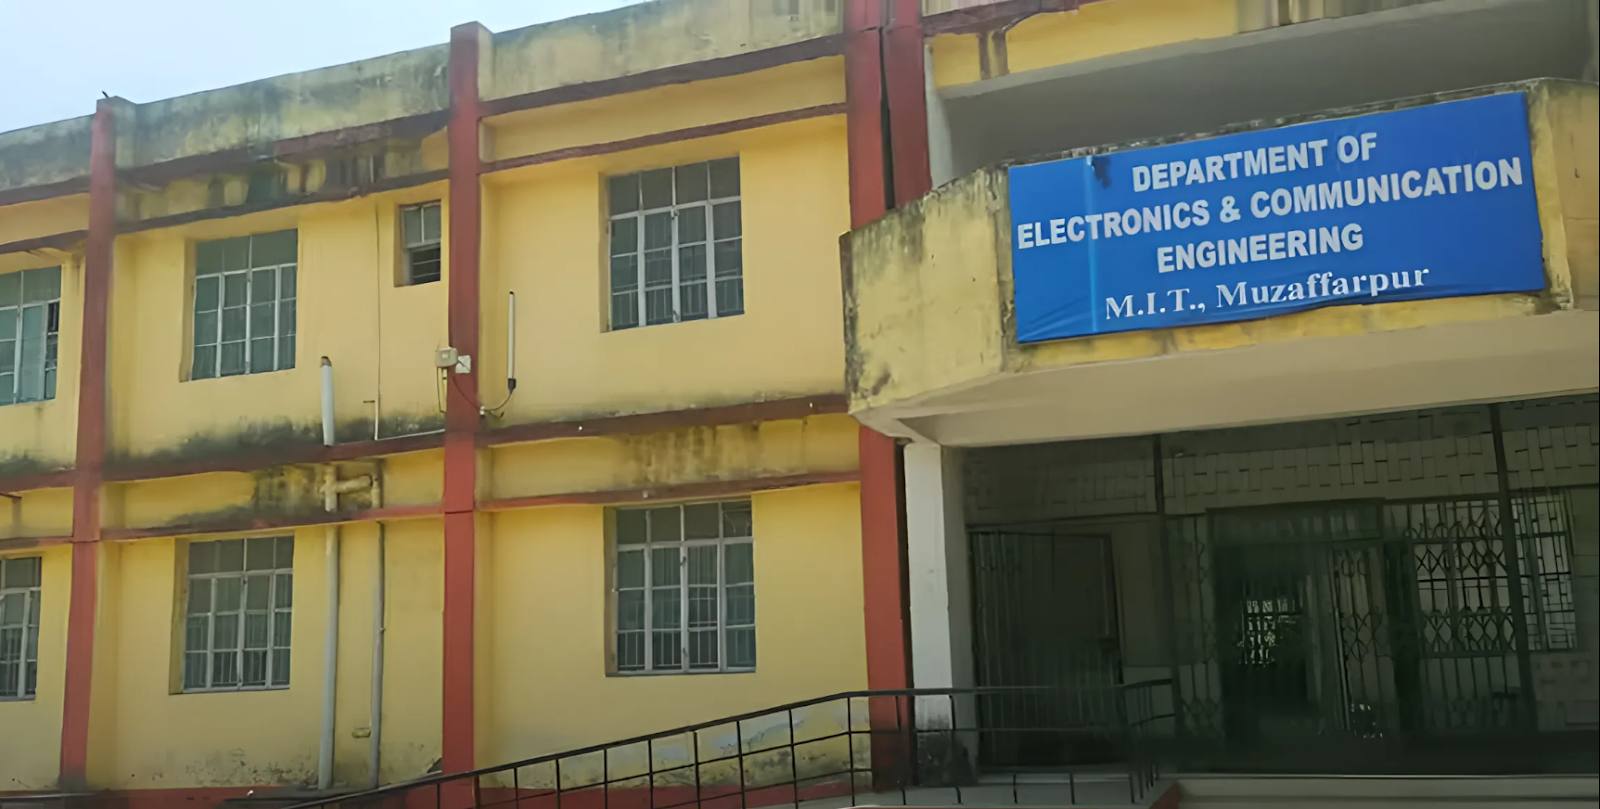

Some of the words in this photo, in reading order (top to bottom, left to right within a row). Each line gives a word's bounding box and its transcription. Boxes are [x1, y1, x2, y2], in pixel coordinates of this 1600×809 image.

[1132, 138, 1328, 193] DEPARTMENT
[1337, 132, 1379, 165] OF
[1017, 199, 1210, 250] ELECTRONICS
[1220, 195, 1242, 223] &
[1250, 157, 1524, 217] COMMUNICATION
[1157, 223, 1364, 274] ENGINEERING
[1105, 289, 1207, 320] M.I.T.,
[1216, 268, 1431, 307] Muzaffarpur
